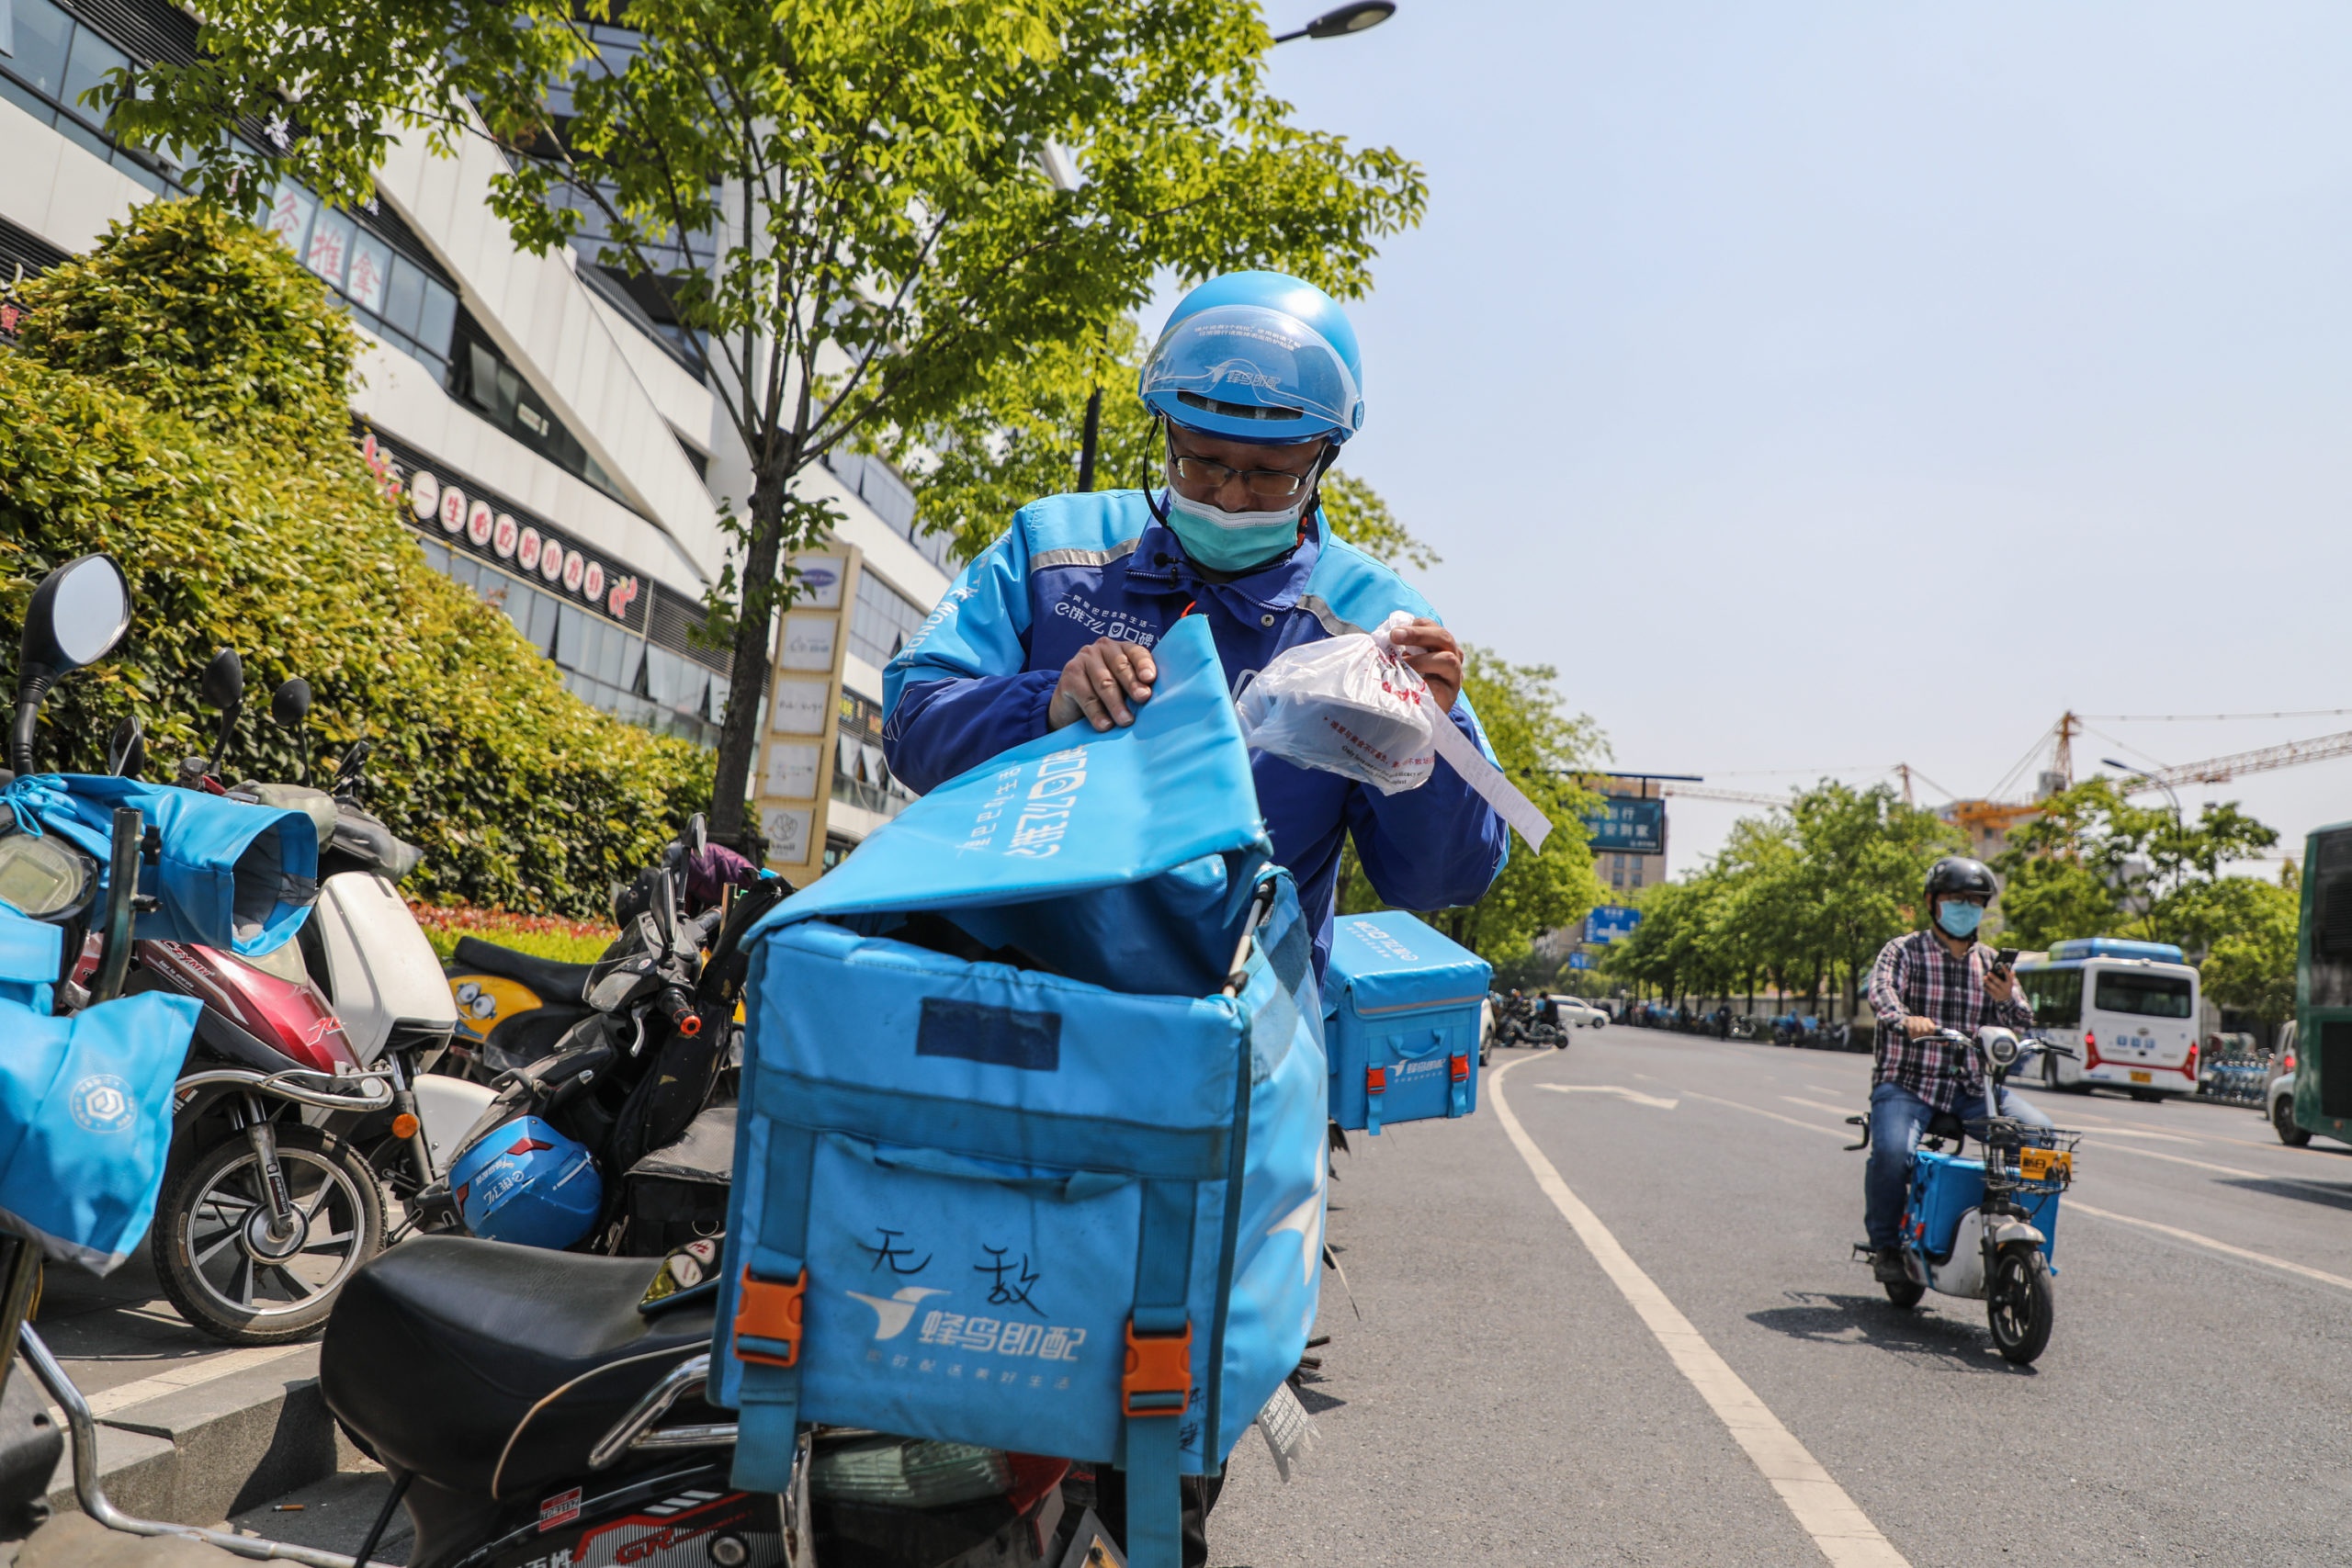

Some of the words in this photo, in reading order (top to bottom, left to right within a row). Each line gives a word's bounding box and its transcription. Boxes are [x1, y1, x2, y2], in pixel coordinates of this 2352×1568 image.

[418, 490, 602, 582] 一生必吃的小龙虾
[1123, 626, 1154, 649] 口碑
[919, 1310, 1087, 1361] 蜂鸟即配
